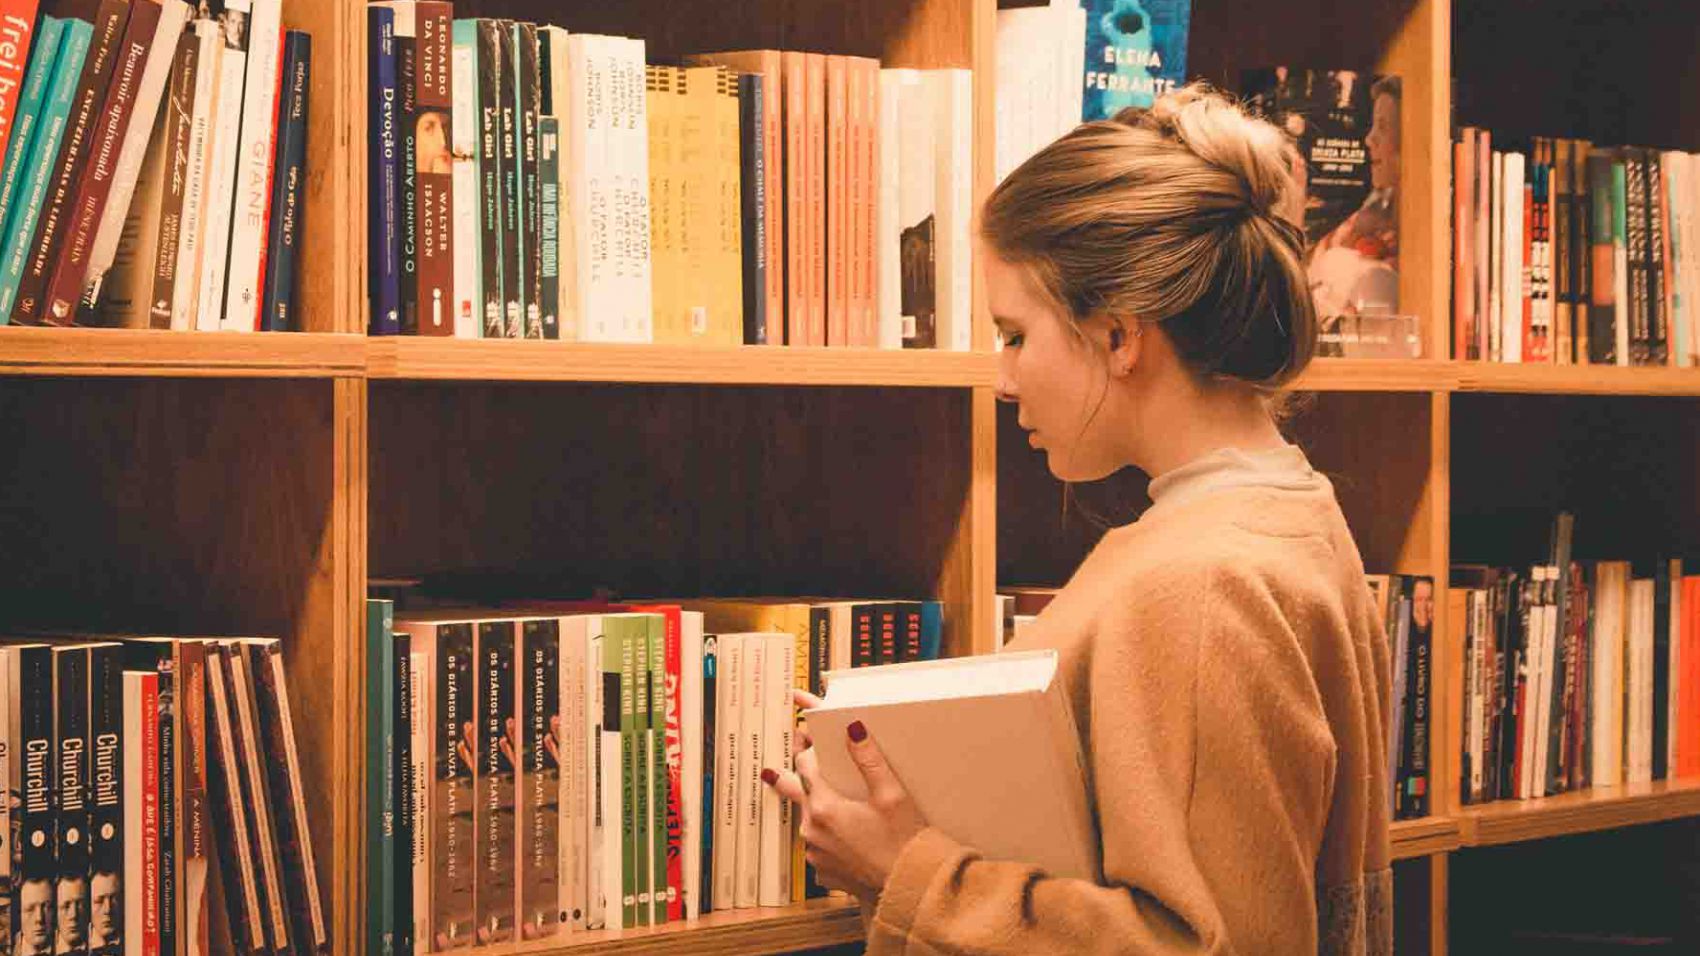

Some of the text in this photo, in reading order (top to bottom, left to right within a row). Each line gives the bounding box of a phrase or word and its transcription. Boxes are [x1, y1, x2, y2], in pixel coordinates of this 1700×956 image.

[424, 20, 433, 88] DA VINCI
[438, 15, 447, 96] LEONARDO
[1085, 71, 1176, 95] FERRANTE
[1103, 45, 1162, 68] ELENA
[93, 41, 145, 182] Beauvoir apaixonada
[380, 87, 395, 159] Devoção
[586, 57, 596, 129] JOHNSON
[609, 56, 620, 128] JOHNSON
[405, 135, 415, 188] ABERTO
[483, 108, 494, 159] Lab Girl
[503, 108, 514, 159] Lab Girl
[525, 110, 535, 162] Lab Girl
[247, 142, 267, 228] GIANE
[424, 183, 433, 258] ISAACSON
[405, 191, 415, 255] CAMINHO
[439, 192, 448, 252] WALTER
[622, 689, 632, 716] KING
[637, 636, 648, 714] STEPHEN KING
[653, 636, 665, 712] STEPHEN KING
[448, 655, 459, 816] OS DIÁRIOS DE SYLVIA PLATH
[490, 652, 501, 810] OS DIÁRIOS DE SYLVIA PLATH
[535, 650, 546, 807] OS DIÁRIOS DE SYLVIA PLATH
[26, 739, 49, 813] Churchill
[61, 736, 84, 811] Churchill
[96, 732, 119, 807] Churchill
[193, 811, 202, 859] MENINA
